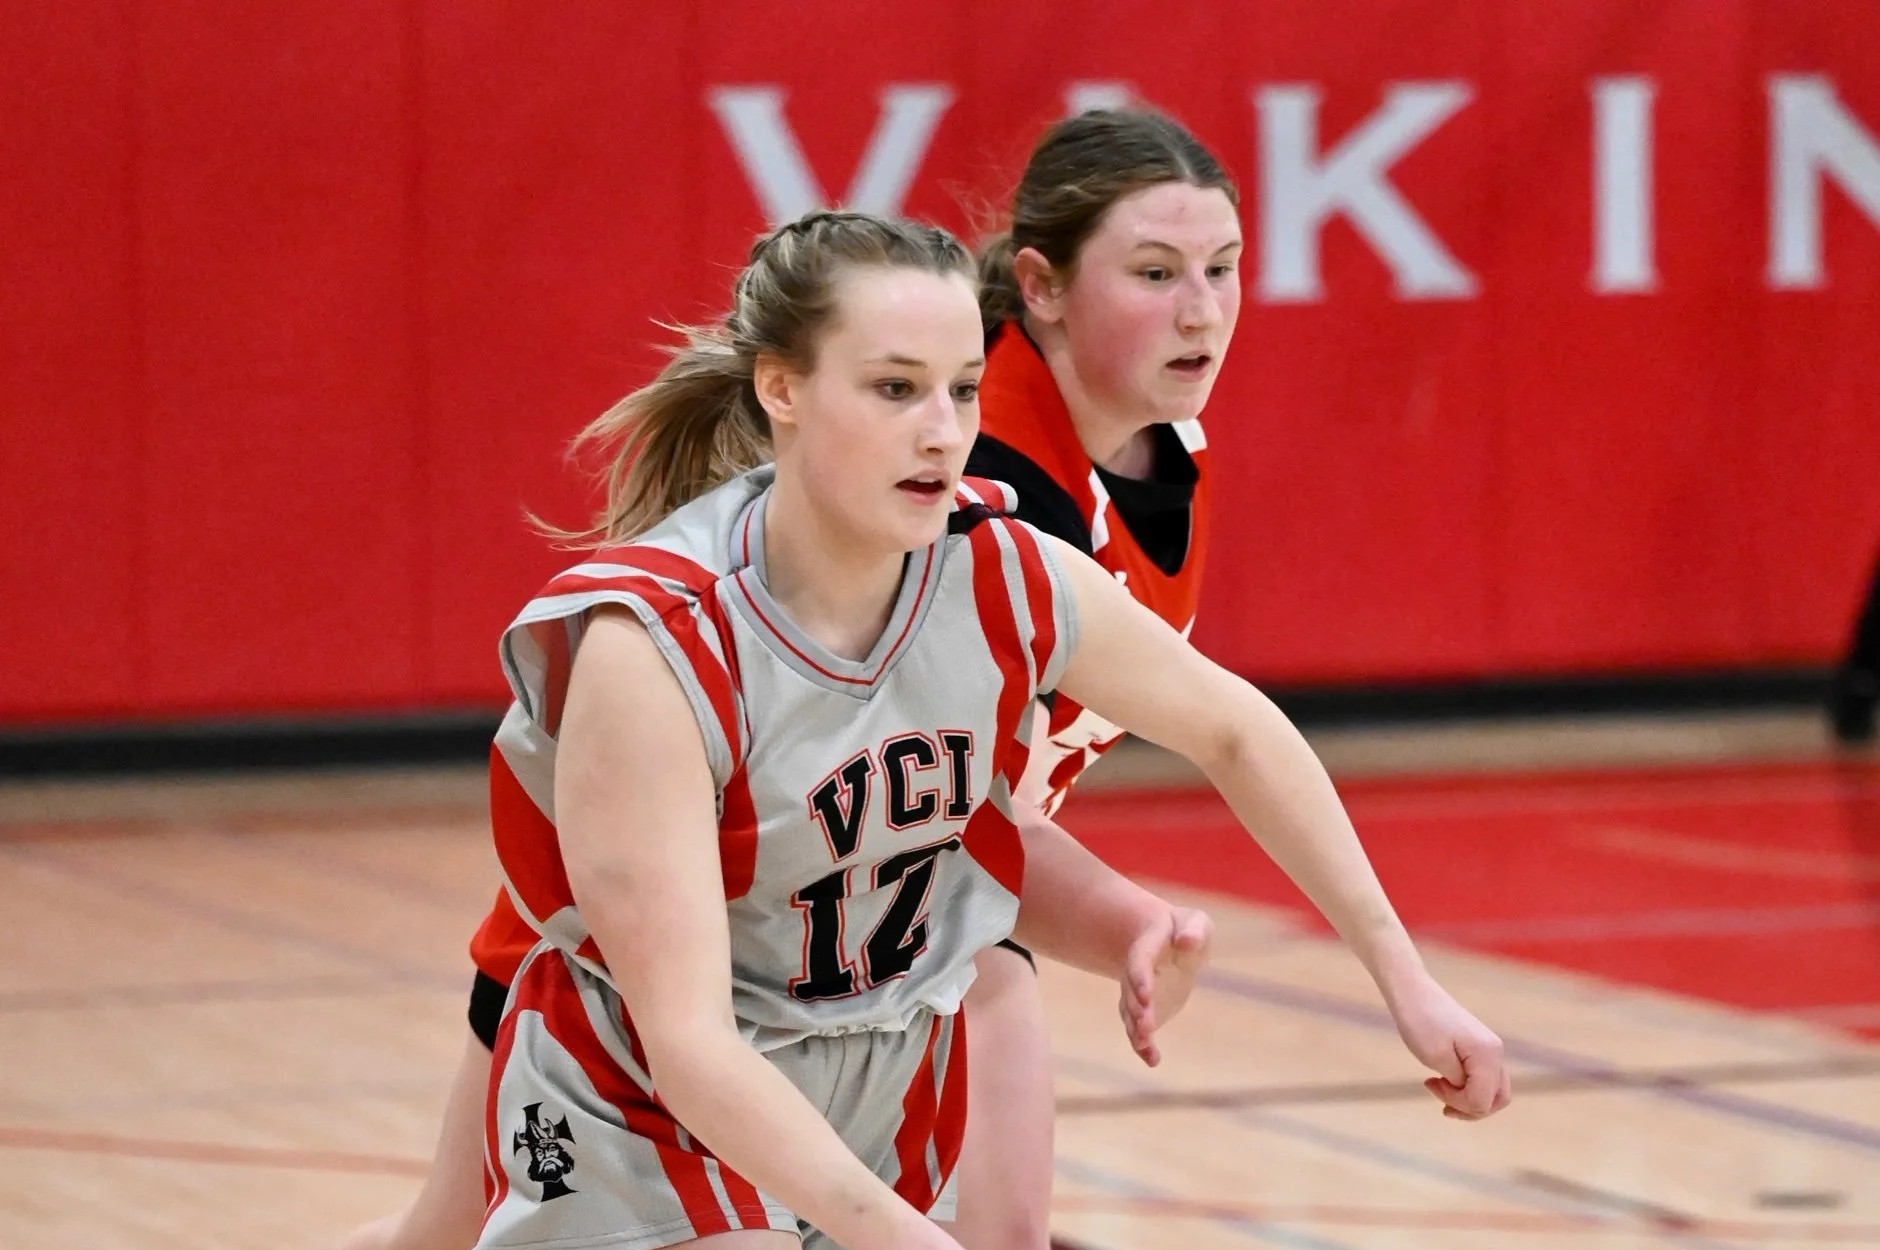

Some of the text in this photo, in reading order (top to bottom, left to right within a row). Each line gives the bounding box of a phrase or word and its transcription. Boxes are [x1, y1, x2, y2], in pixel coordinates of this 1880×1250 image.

[706, 74, 1880, 301] VKIN
[807, 730, 974, 863] VCI
[788, 831, 963, 1003] 12
